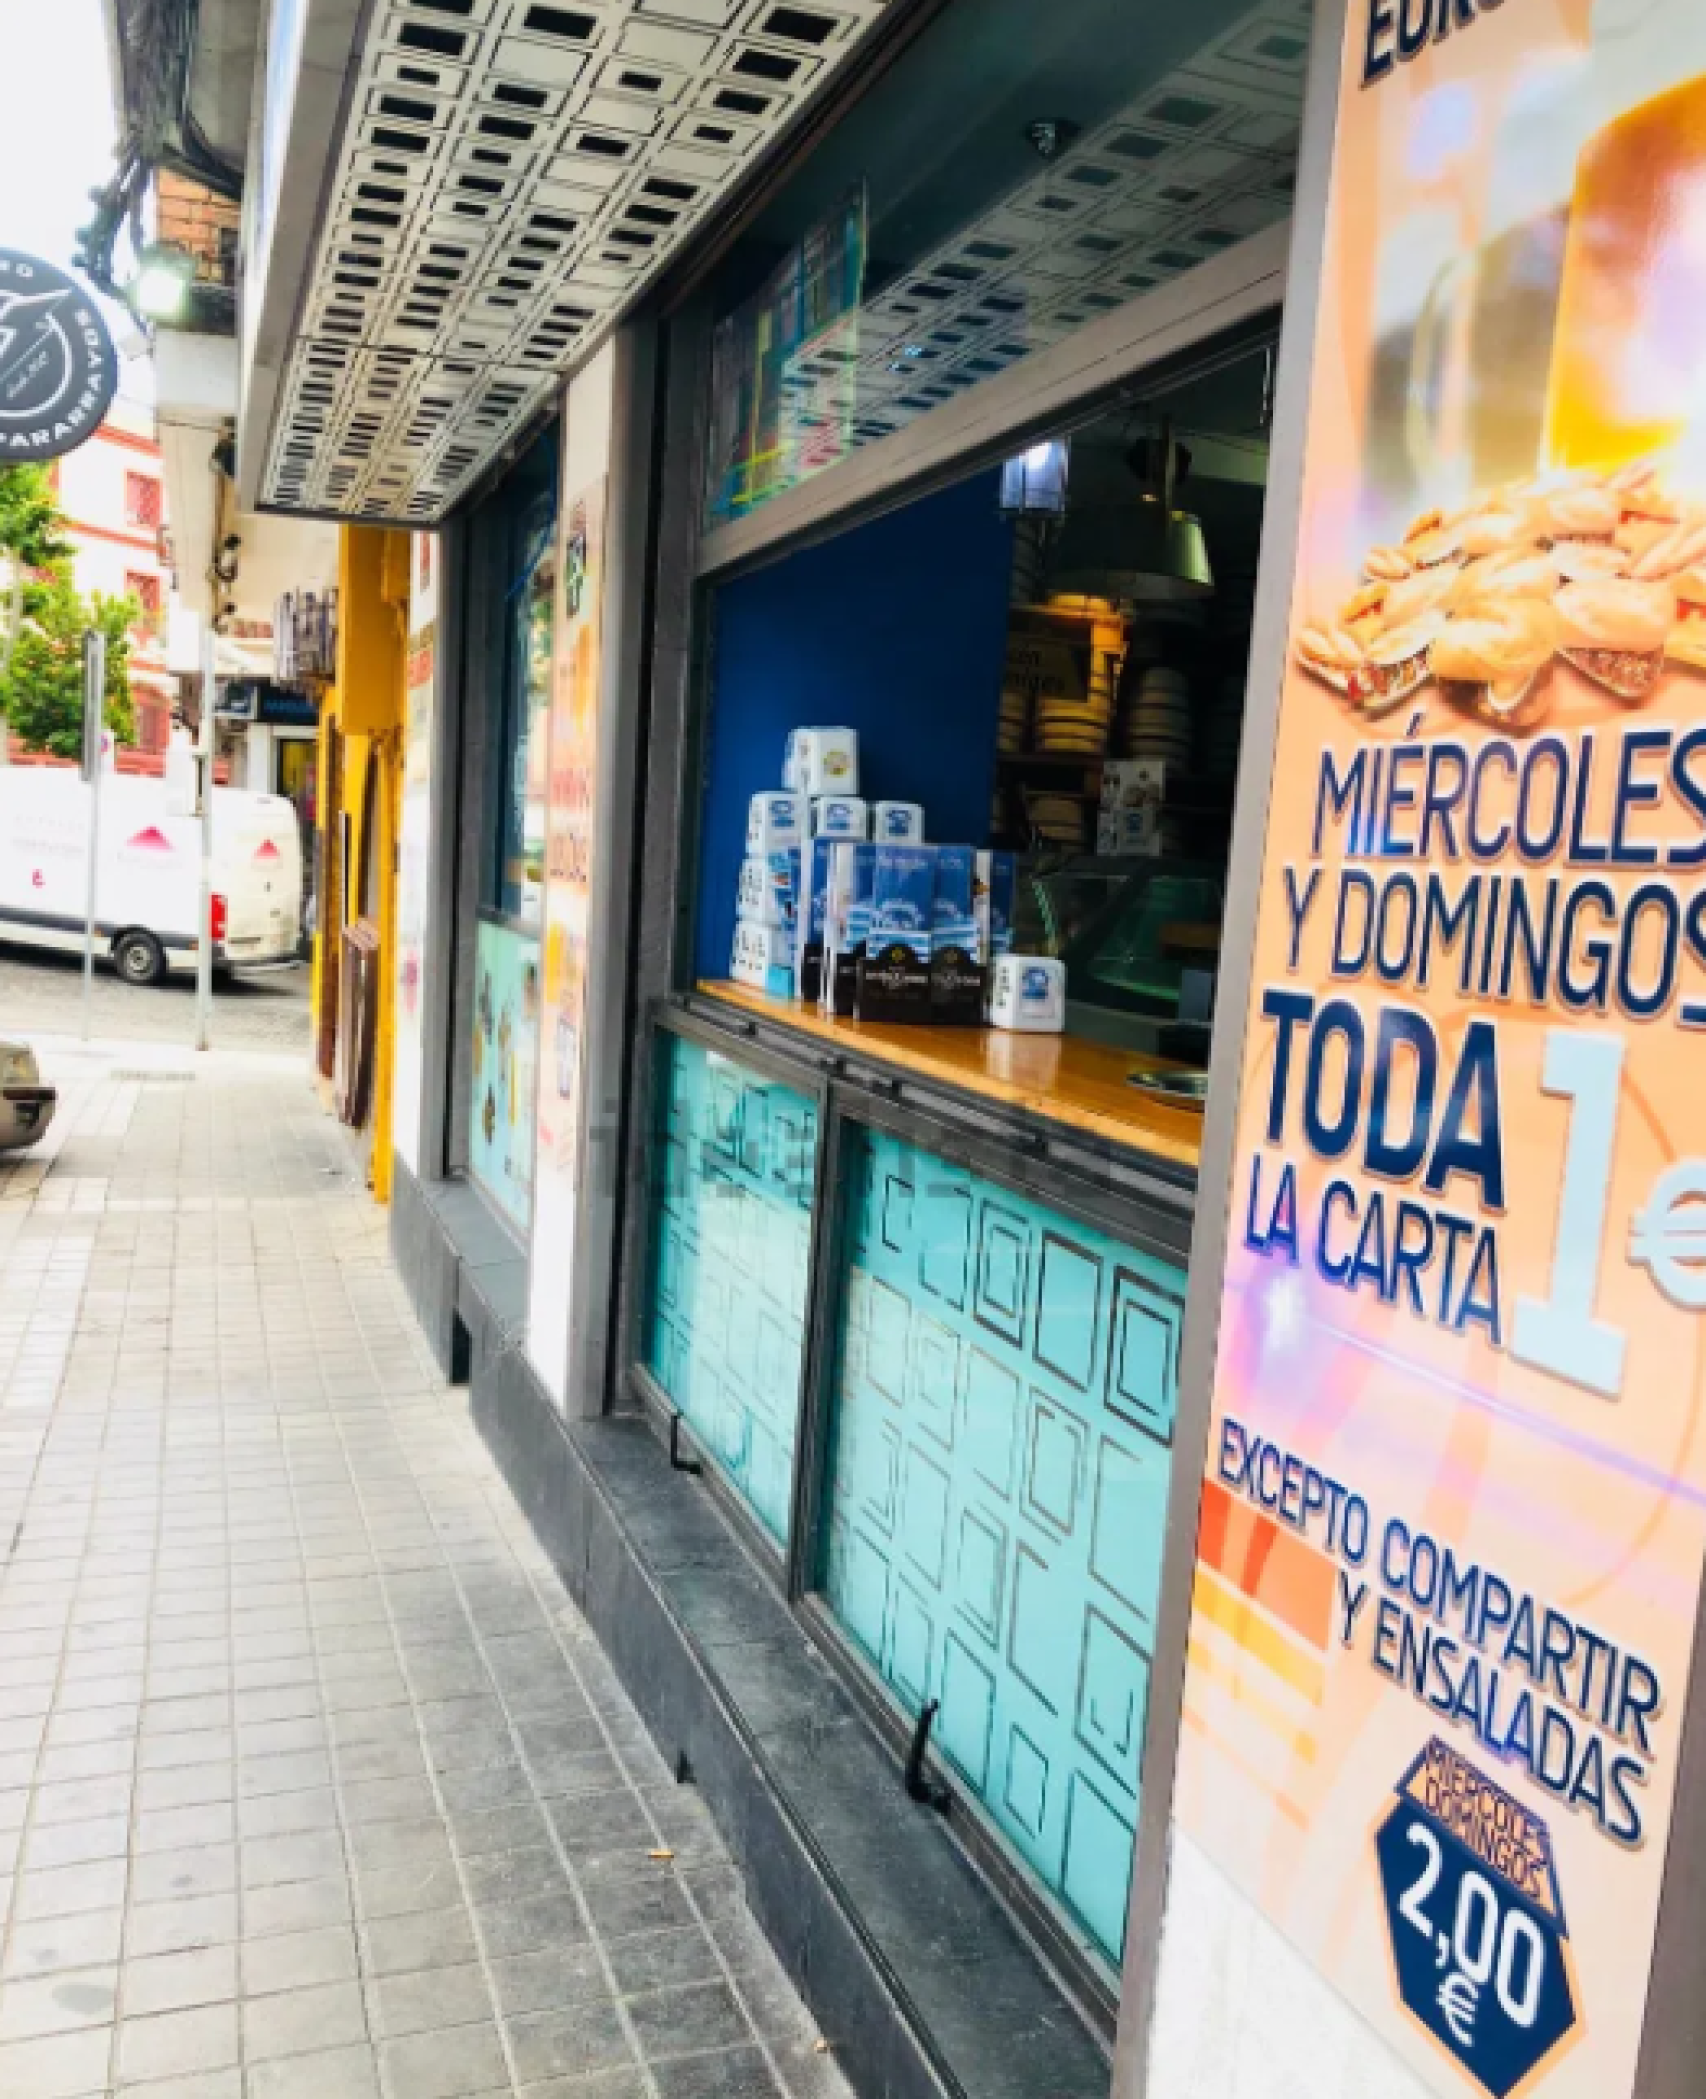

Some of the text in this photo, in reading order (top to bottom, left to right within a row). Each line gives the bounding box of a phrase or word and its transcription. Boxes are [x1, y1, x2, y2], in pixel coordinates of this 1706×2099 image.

[1283, 867, 1320, 974] Y
[1261, 987, 1505, 1212] TODA
[1244, 1153, 1501, 1350] LA CARTA
[1219, 1418, 1662, 1753] EXCEPTO COMPARTIR
[1338, 1570, 1646, 1848] Y ENSALADAS
[1399, 1822, 1544, 2028] 2,00
[1435, 1973, 1477, 2048] €
